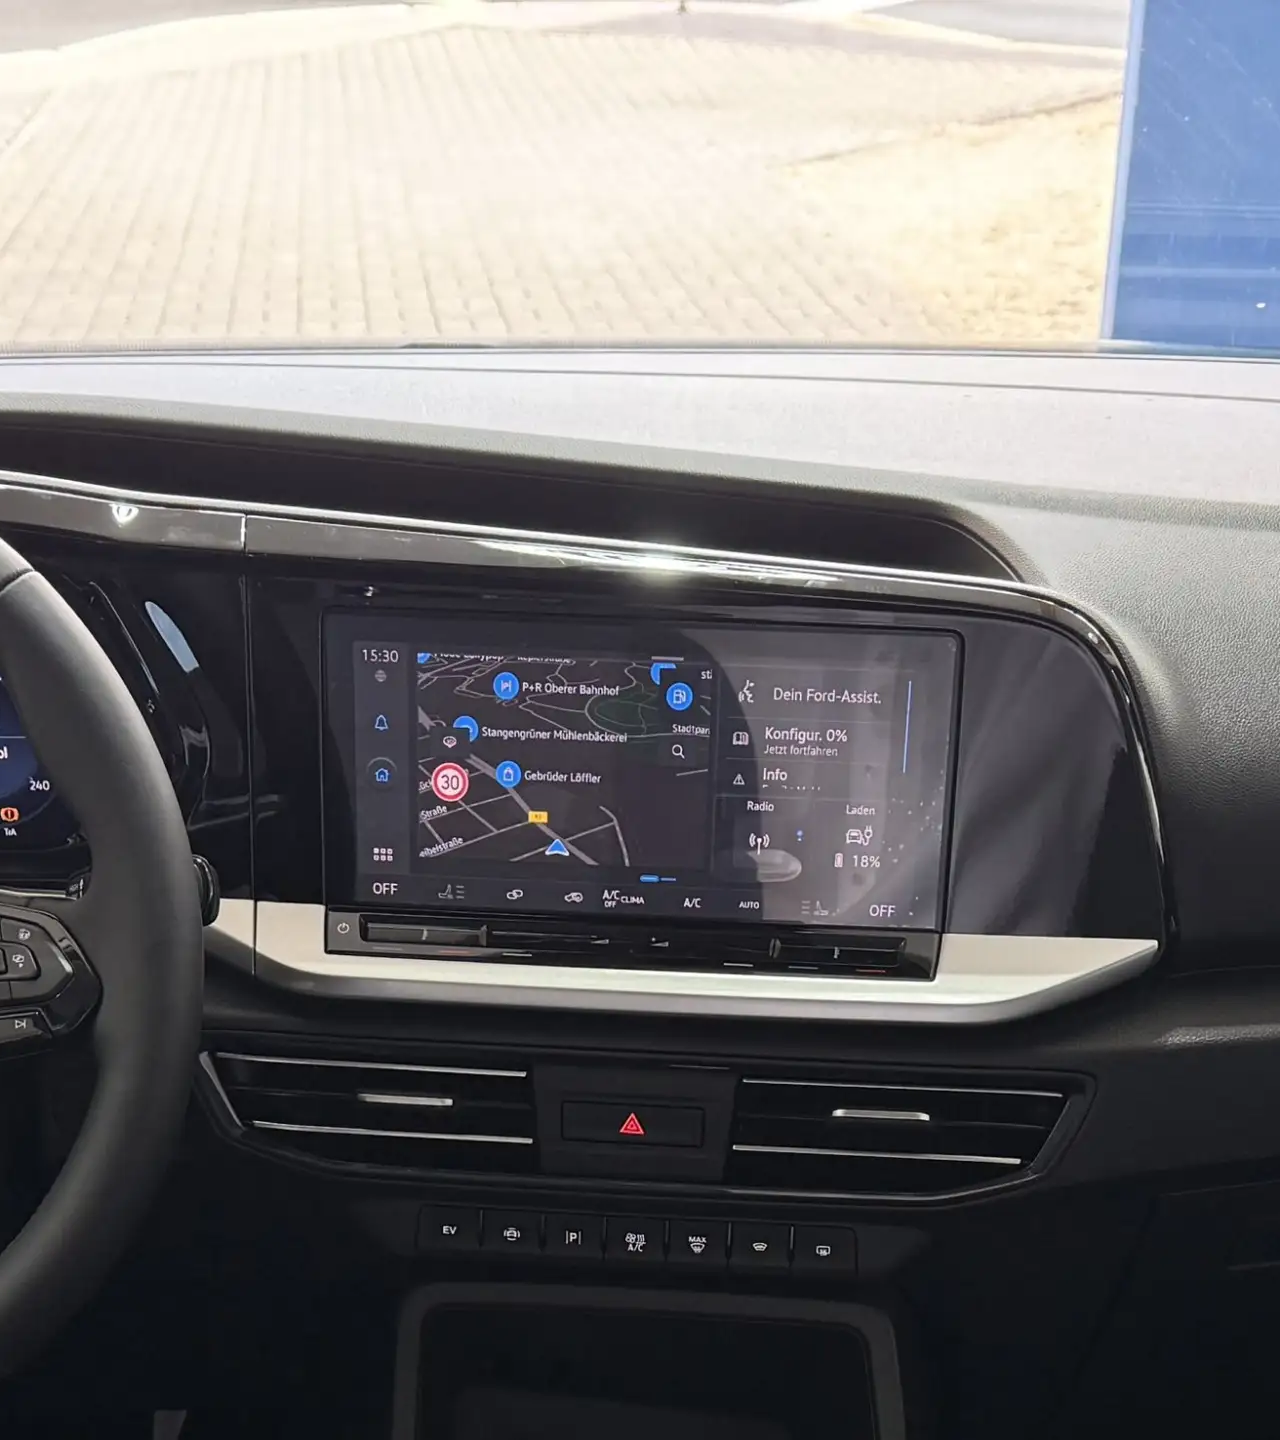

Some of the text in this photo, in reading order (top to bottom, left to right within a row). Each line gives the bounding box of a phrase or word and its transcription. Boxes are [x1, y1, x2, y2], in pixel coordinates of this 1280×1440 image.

[362, 649, 399, 663] 15:30
[522, 682, 620, 696] P+R Oberer Bahnhof
[773, 687, 881, 705] Dein Ford-Assist.
[481, 726, 628, 743] Stangengrüner Mühlenbäckerei
[765, 726, 848, 744] Konfigur. 0%
[764, 744, 838, 758] Jetzt fortfahren
[524, 769, 601, 784] Gebrüder Löffler
[763, 768, 788, 782] Info
[29, 780, 50, 791] 240
[441, 774, 459, 791] 30
[747, 800, 775, 813] Radio
[846, 804, 876, 816] Laden
[852, 855, 881, 869] 18%
[372, 883, 399, 896] OFF
[602, 889, 620, 901] A/C
[620, 895, 645, 905] CLIMA
[683, 897, 702, 909] A/C
[739, 901, 760, 909] AUTO
[869, 904, 896, 918] OFF
[442, 1225, 457, 1235] EV
[627, 1242, 644, 1252] A/C
